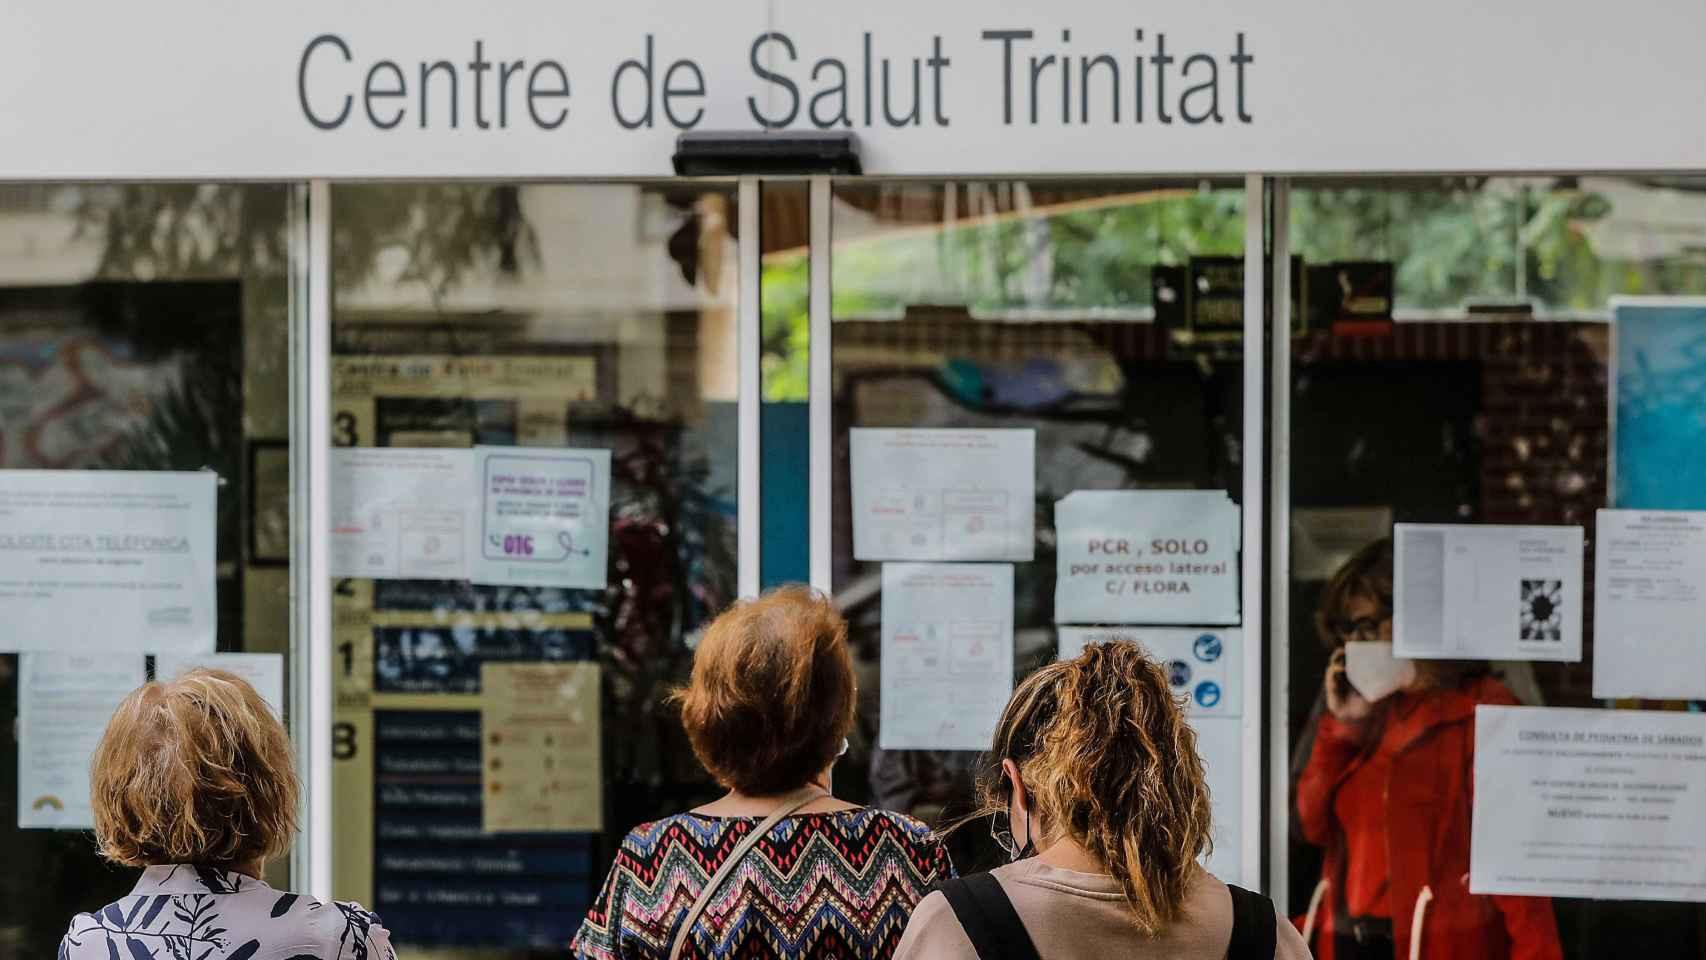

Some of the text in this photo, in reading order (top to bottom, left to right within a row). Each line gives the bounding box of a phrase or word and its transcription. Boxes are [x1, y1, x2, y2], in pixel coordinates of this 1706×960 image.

[298, 29, 1254, 130] Centre de Salut Trinitat
[334, 411, 358, 448] 3
[503, 535, 534, 555] 016
[1088, 539, 1129, 555] PCR
[1151, 538, 1209, 555] SOLO
[1070, 561, 1227, 576] por acceso lateral
[1105, 581, 1190, 593] C/ FLORA
[337, 641, 353, 679] 1
